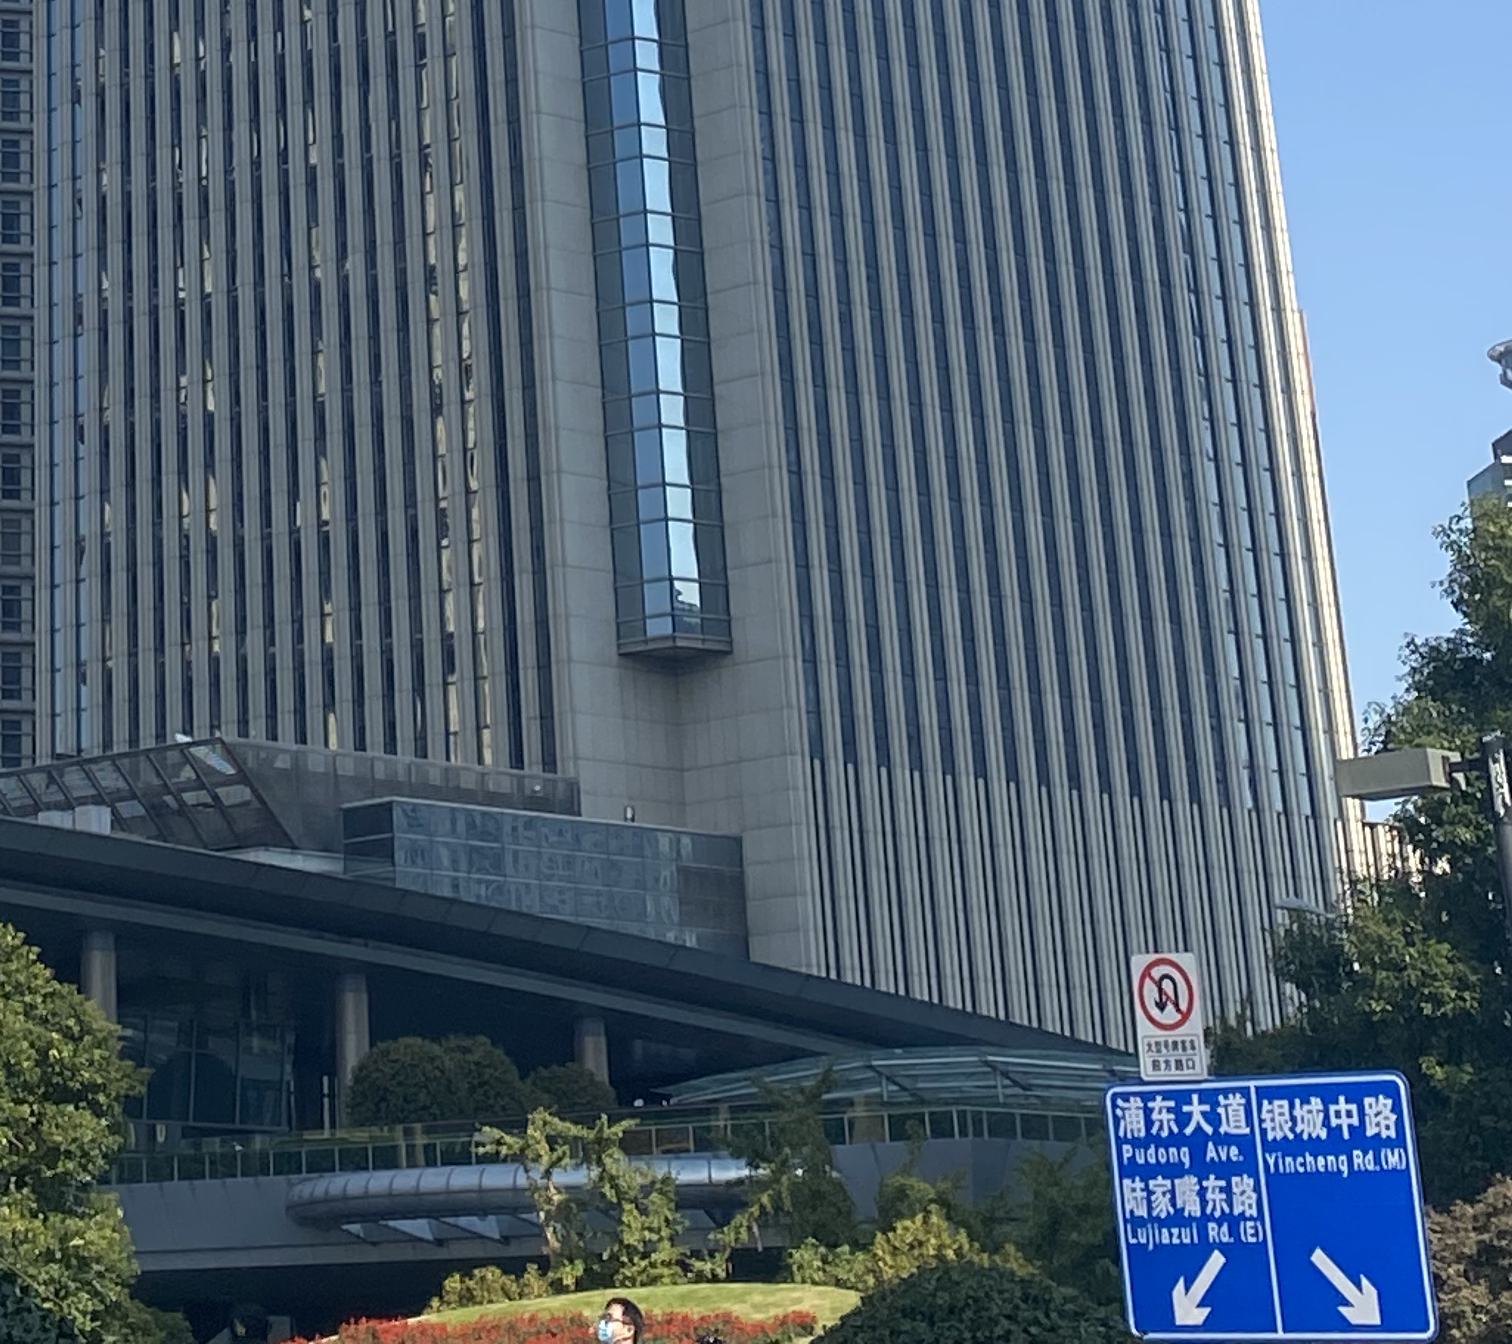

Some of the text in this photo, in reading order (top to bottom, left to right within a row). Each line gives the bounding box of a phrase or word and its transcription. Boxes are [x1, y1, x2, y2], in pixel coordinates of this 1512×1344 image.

[1115, 1093, 1251, 1139] 浦东大道
[1260, 1094, 1398, 1142] 银城中路
[1122, 1141, 1245, 1169] Pudong Ave.
[1265, 1151, 1349, 1178] Yincheng
[1122, 1173, 1258, 1219] 陆家嘴东路
[1126, 1222, 1199, 1252] Lujiazui
